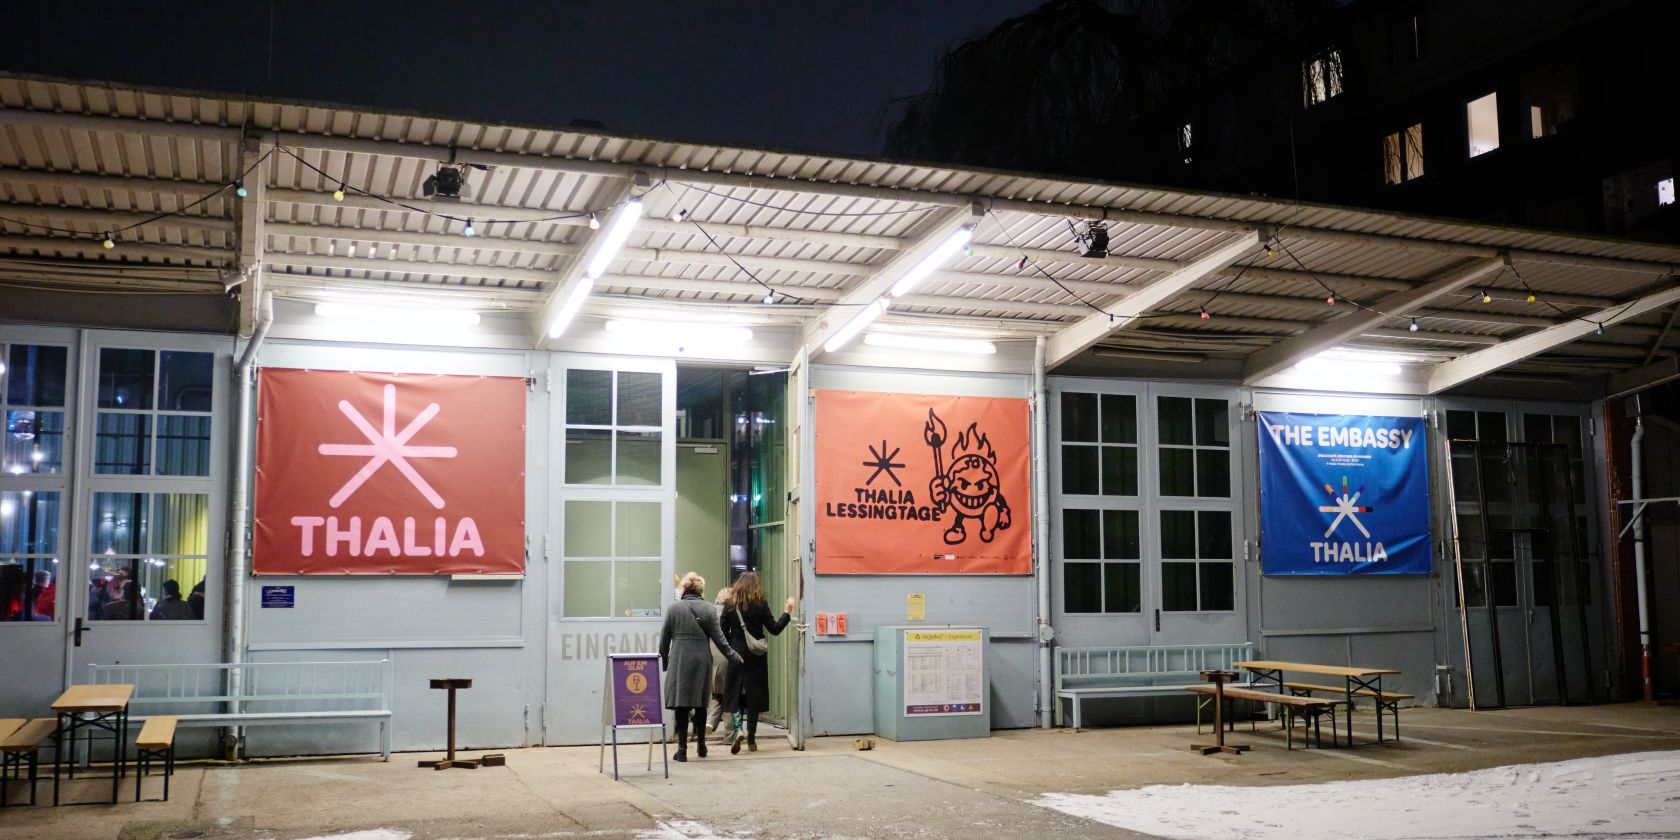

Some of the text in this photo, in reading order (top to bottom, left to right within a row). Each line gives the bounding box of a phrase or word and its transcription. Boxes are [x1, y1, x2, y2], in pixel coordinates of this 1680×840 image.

[1270, 424, 1413, 449] THE EMBASSY
[854, 488, 915, 505] THALIA
[826, 502, 942, 522] LESSINGTAGE
[290, 515, 485, 557] THALIA
[1310, 542, 1388, 563] THALIA
